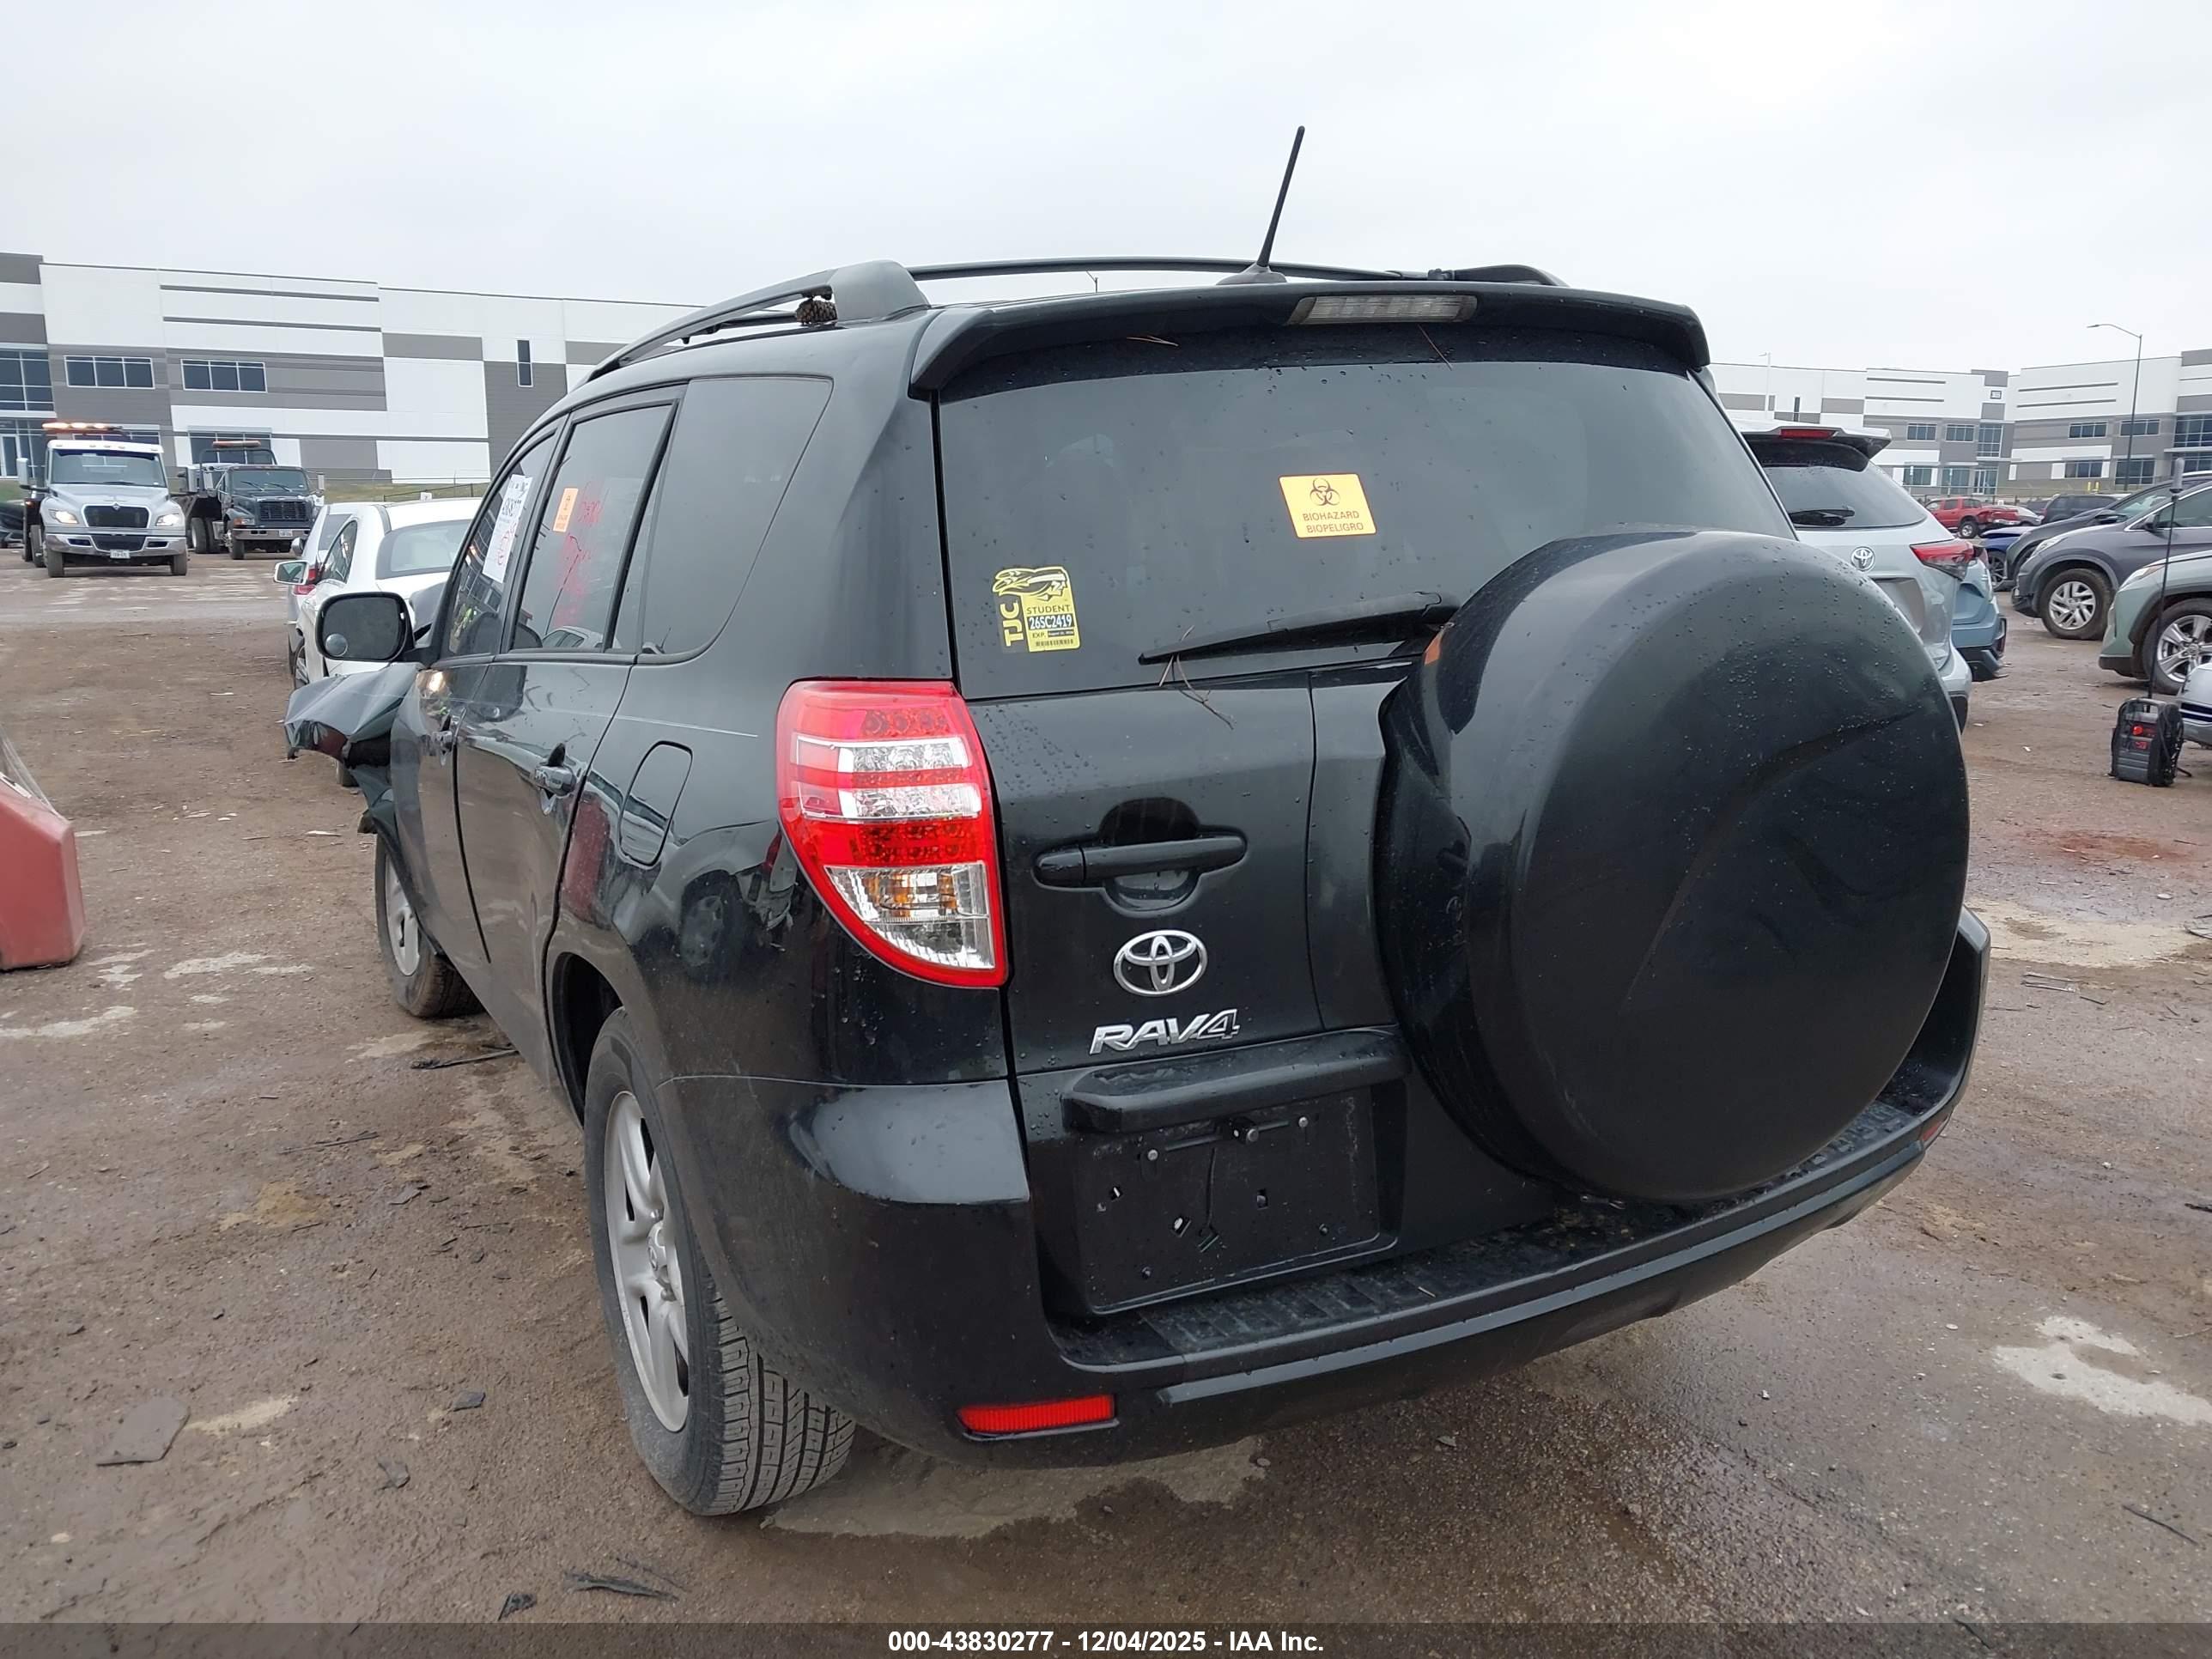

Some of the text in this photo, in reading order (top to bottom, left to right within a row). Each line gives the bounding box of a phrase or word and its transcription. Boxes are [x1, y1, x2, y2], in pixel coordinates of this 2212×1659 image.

[1302, 510, 1360, 521] BIOHAZARD
[1306, 522, 1364, 533] BIOPELIGRO
[1027, 605, 1070, 614] STUDENT
[1000, 601, 1024, 646] TJC
[1030, 616, 1072, 629] 26SC2419
[1089, 1009, 1241, 1054] RAV4
